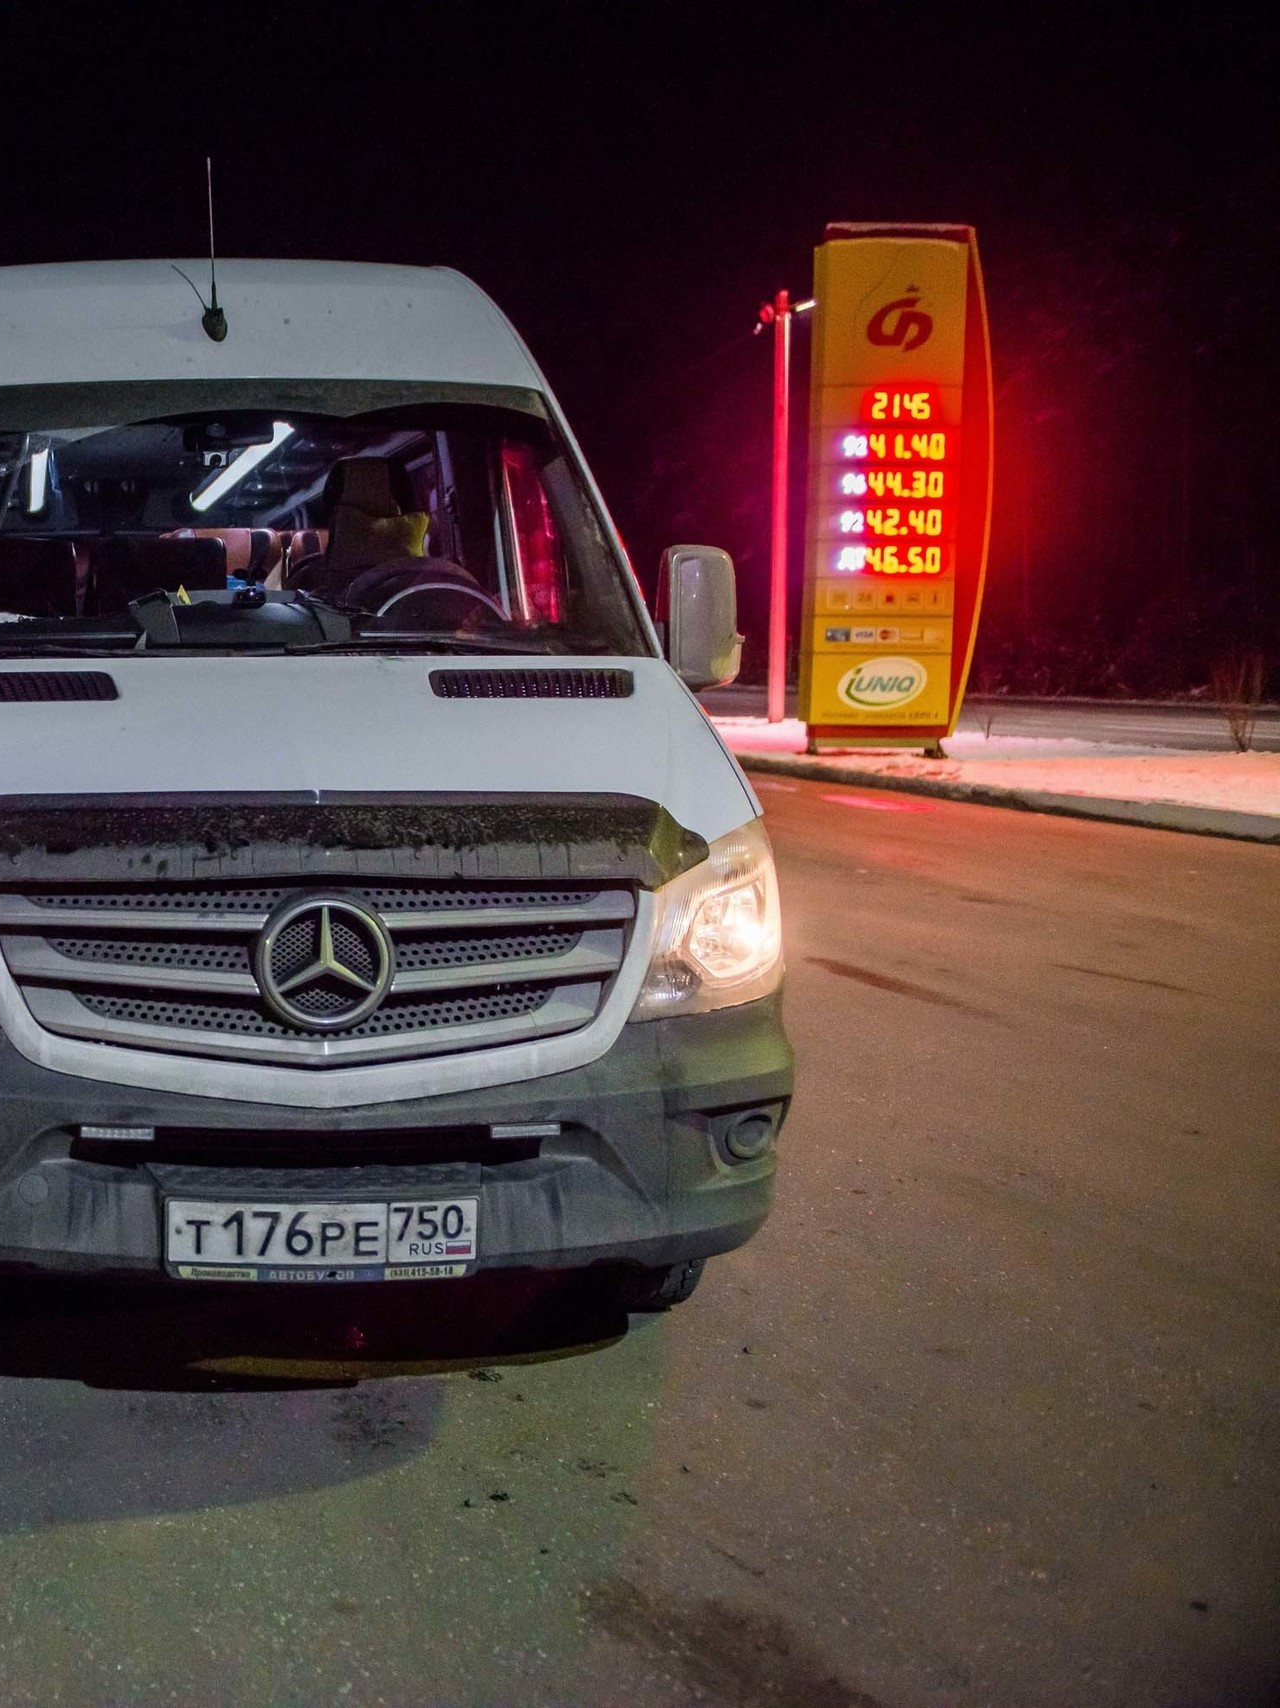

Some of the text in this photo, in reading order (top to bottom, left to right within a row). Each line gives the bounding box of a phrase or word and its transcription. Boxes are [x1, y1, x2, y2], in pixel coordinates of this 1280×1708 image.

[869, 432, 946, 460] 41.40
[867, 471, 944, 499] 44.30
[865, 508, 942, 536] 42.40
[866, 545, 941, 574] 46.50
[393, 1204, 464, 1243] 750
[409, 1242, 444, 1256] RUS
[268, 1270, 355, 1281] АВТОБУОВ
